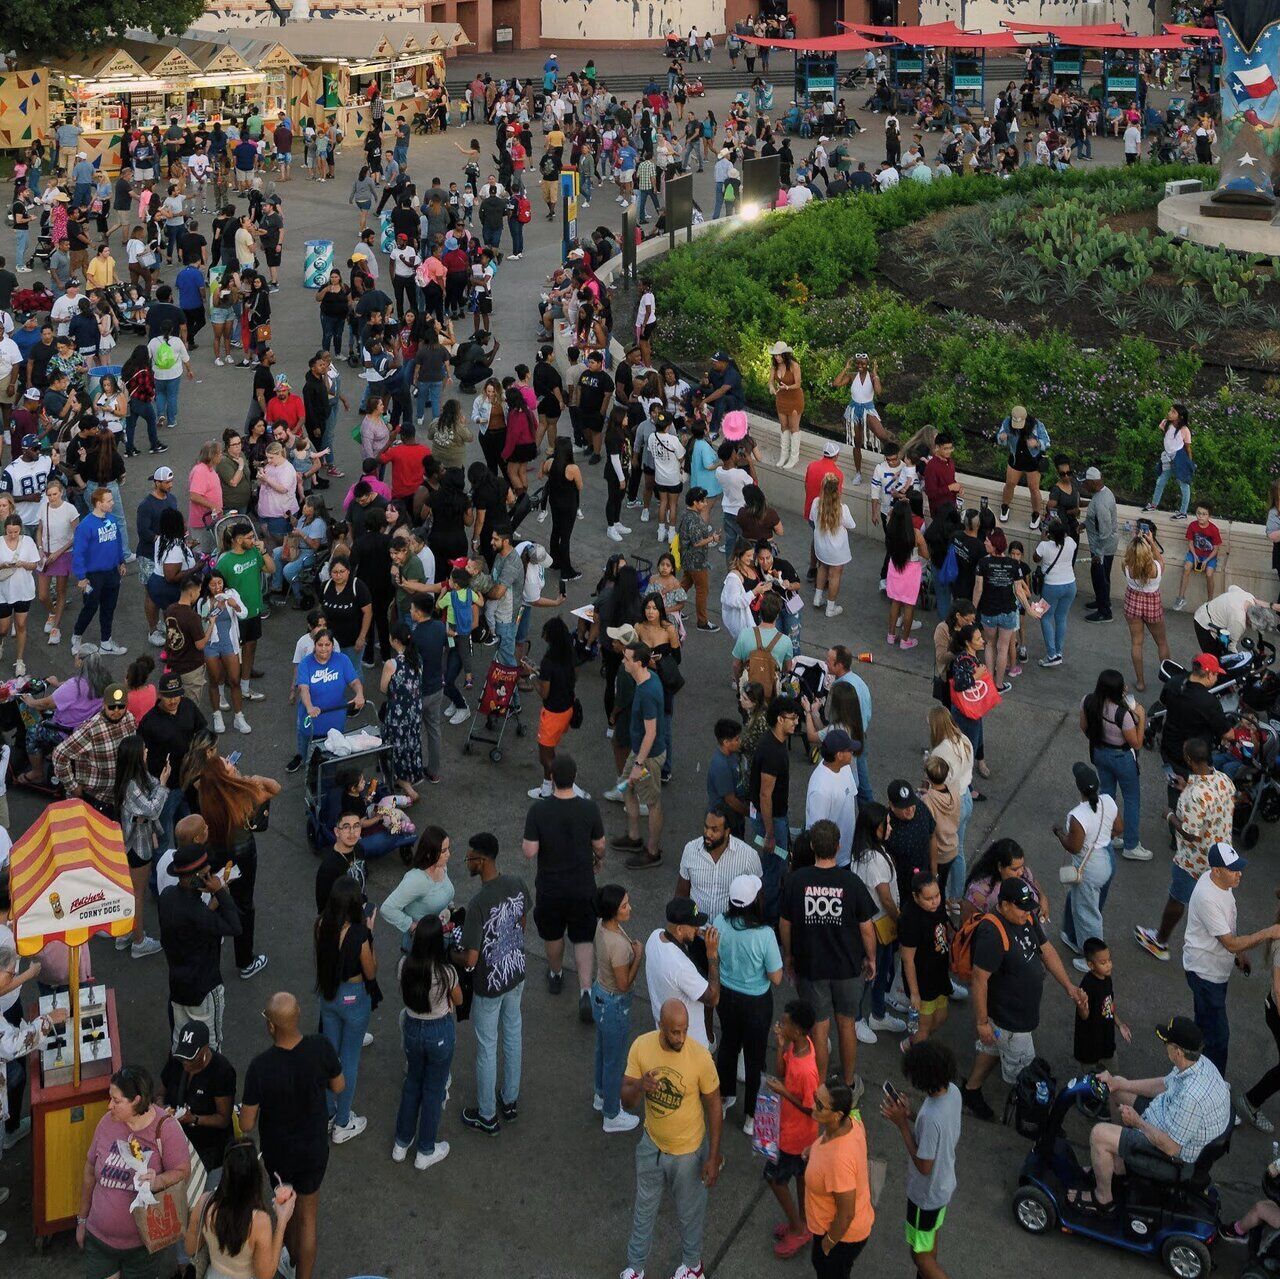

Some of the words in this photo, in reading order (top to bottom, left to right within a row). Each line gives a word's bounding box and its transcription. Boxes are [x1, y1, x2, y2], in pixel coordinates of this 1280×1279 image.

[20, 473, 47, 495] 88
[315, 667, 329, 677] JUST
[805, 886, 844, 898] ANGRY
[70, 889, 106, 911] Fletcher's
[805, 896, 843, 917] DOG
[79, 907, 102, 919] CORNY
[103, 904, 121, 915] DOGS
[181, 1030, 195, 1043] M
[100, 1179, 133, 1191] HUMA
